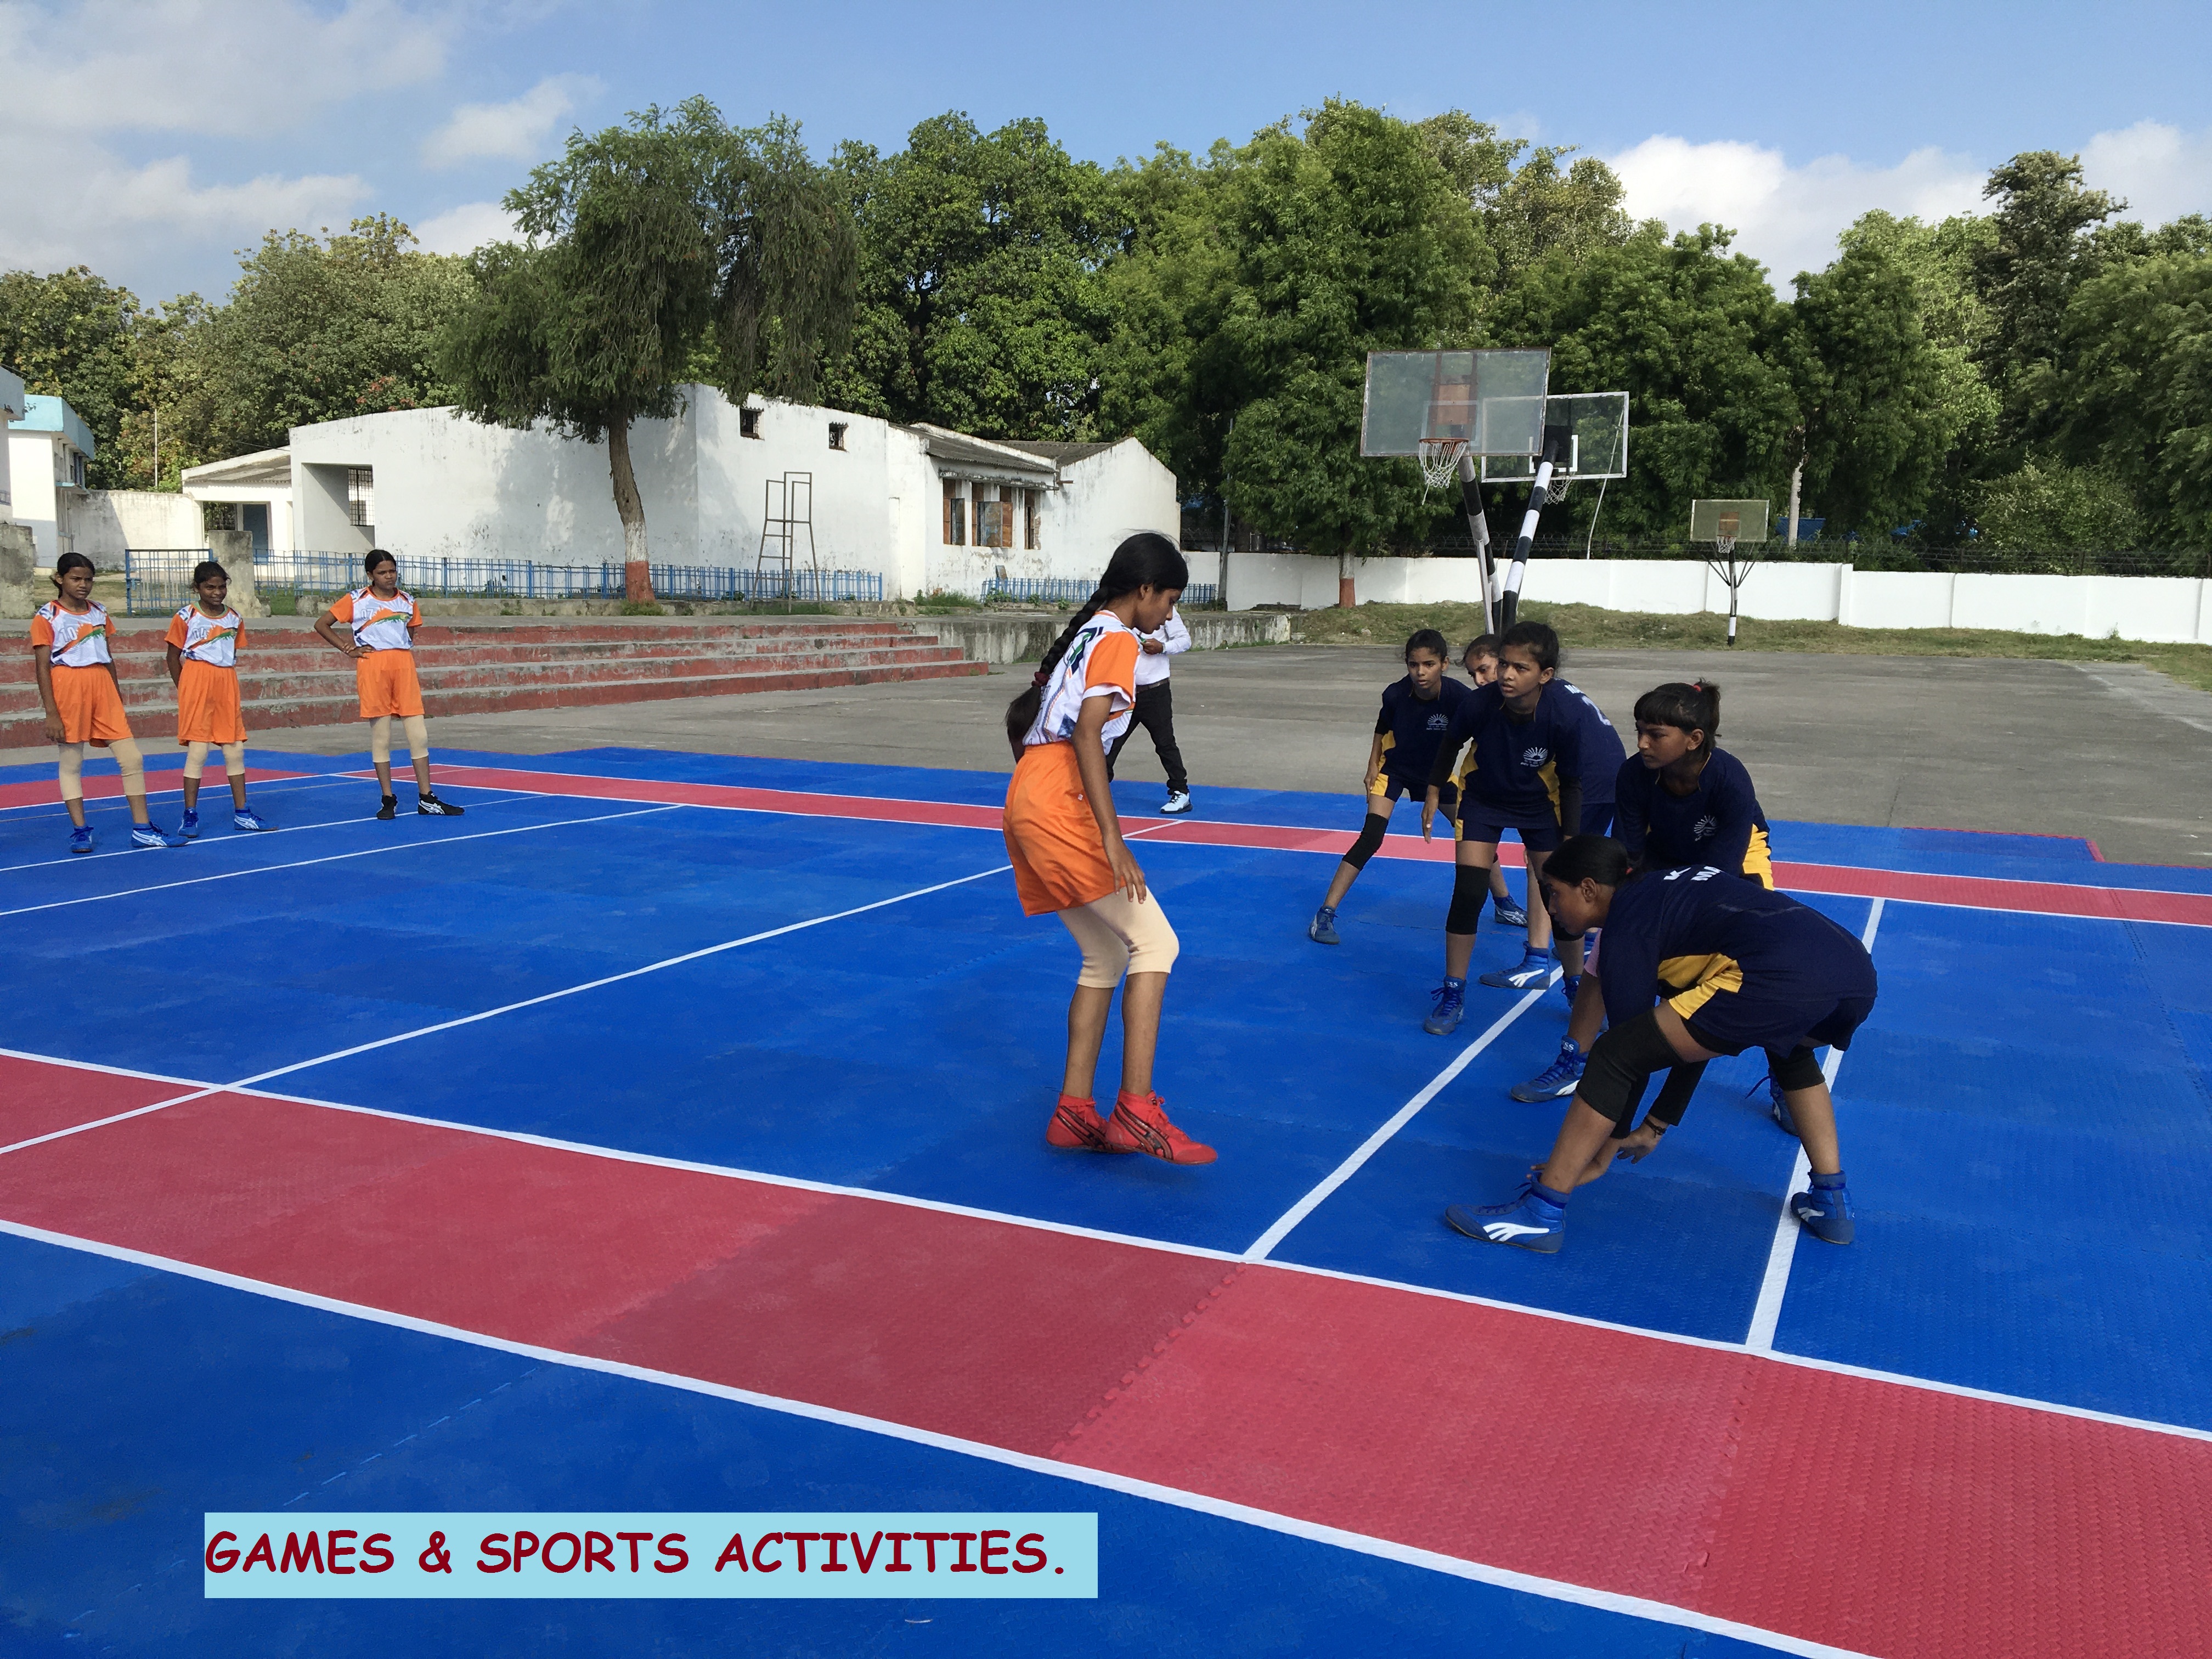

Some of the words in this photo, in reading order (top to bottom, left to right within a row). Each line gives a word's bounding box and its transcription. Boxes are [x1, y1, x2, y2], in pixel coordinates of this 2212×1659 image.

[360, 608, 374, 621] 07
[59, 627, 78, 642] 10
[192, 627, 208, 641] 04
